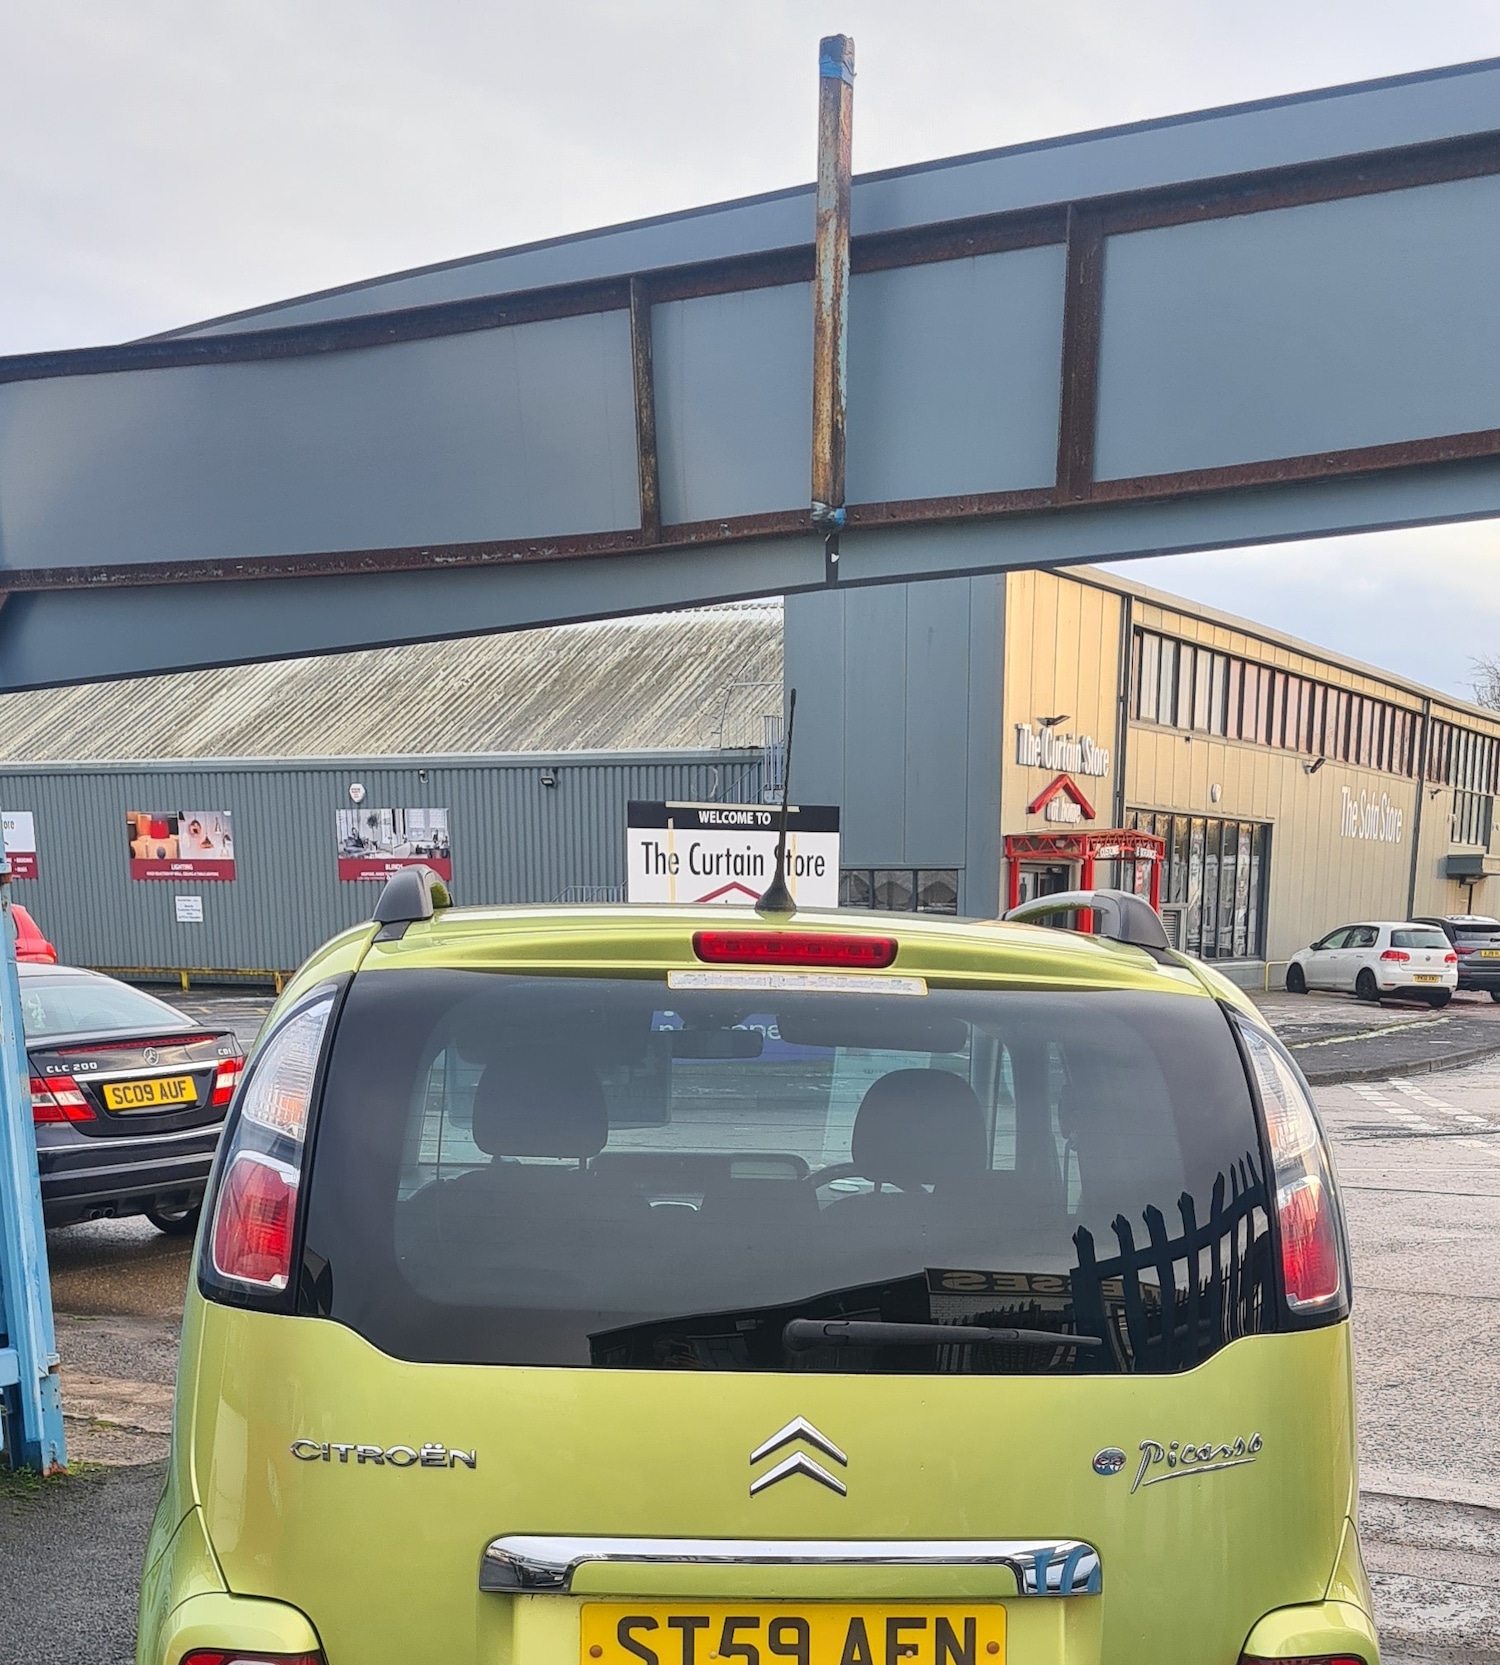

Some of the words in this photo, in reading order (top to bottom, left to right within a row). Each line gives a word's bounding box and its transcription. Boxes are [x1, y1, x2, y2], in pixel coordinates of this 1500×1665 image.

[1016, 723, 1040, 766] The
[1041, 727, 1081, 773] Curtain
[1082, 735, 1110, 777] Store
[698, 810, 754, 825] WELCOME
[755, 812, 771, 825] TO
[1062, 796, 1081, 823] home
[1341, 785, 1358, 838] The
[1359, 788, 1379, 840] Sofa
[1380, 791, 1403, 843] Store
[641, 841, 680, 876] The
[689, 842, 764, 876] Curtain
[217, 1047, 232, 1056] CDI
[46, 1064, 69, 1074] CLC
[72, 1061, 98, 1071] 200
[111, 1084, 155, 1105] SC09
[160, 1080, 187, 1101] AUF
[290, 1438, 476, 1469] CITROËN
[1130, 1431, 1263, 1495] Picasso
